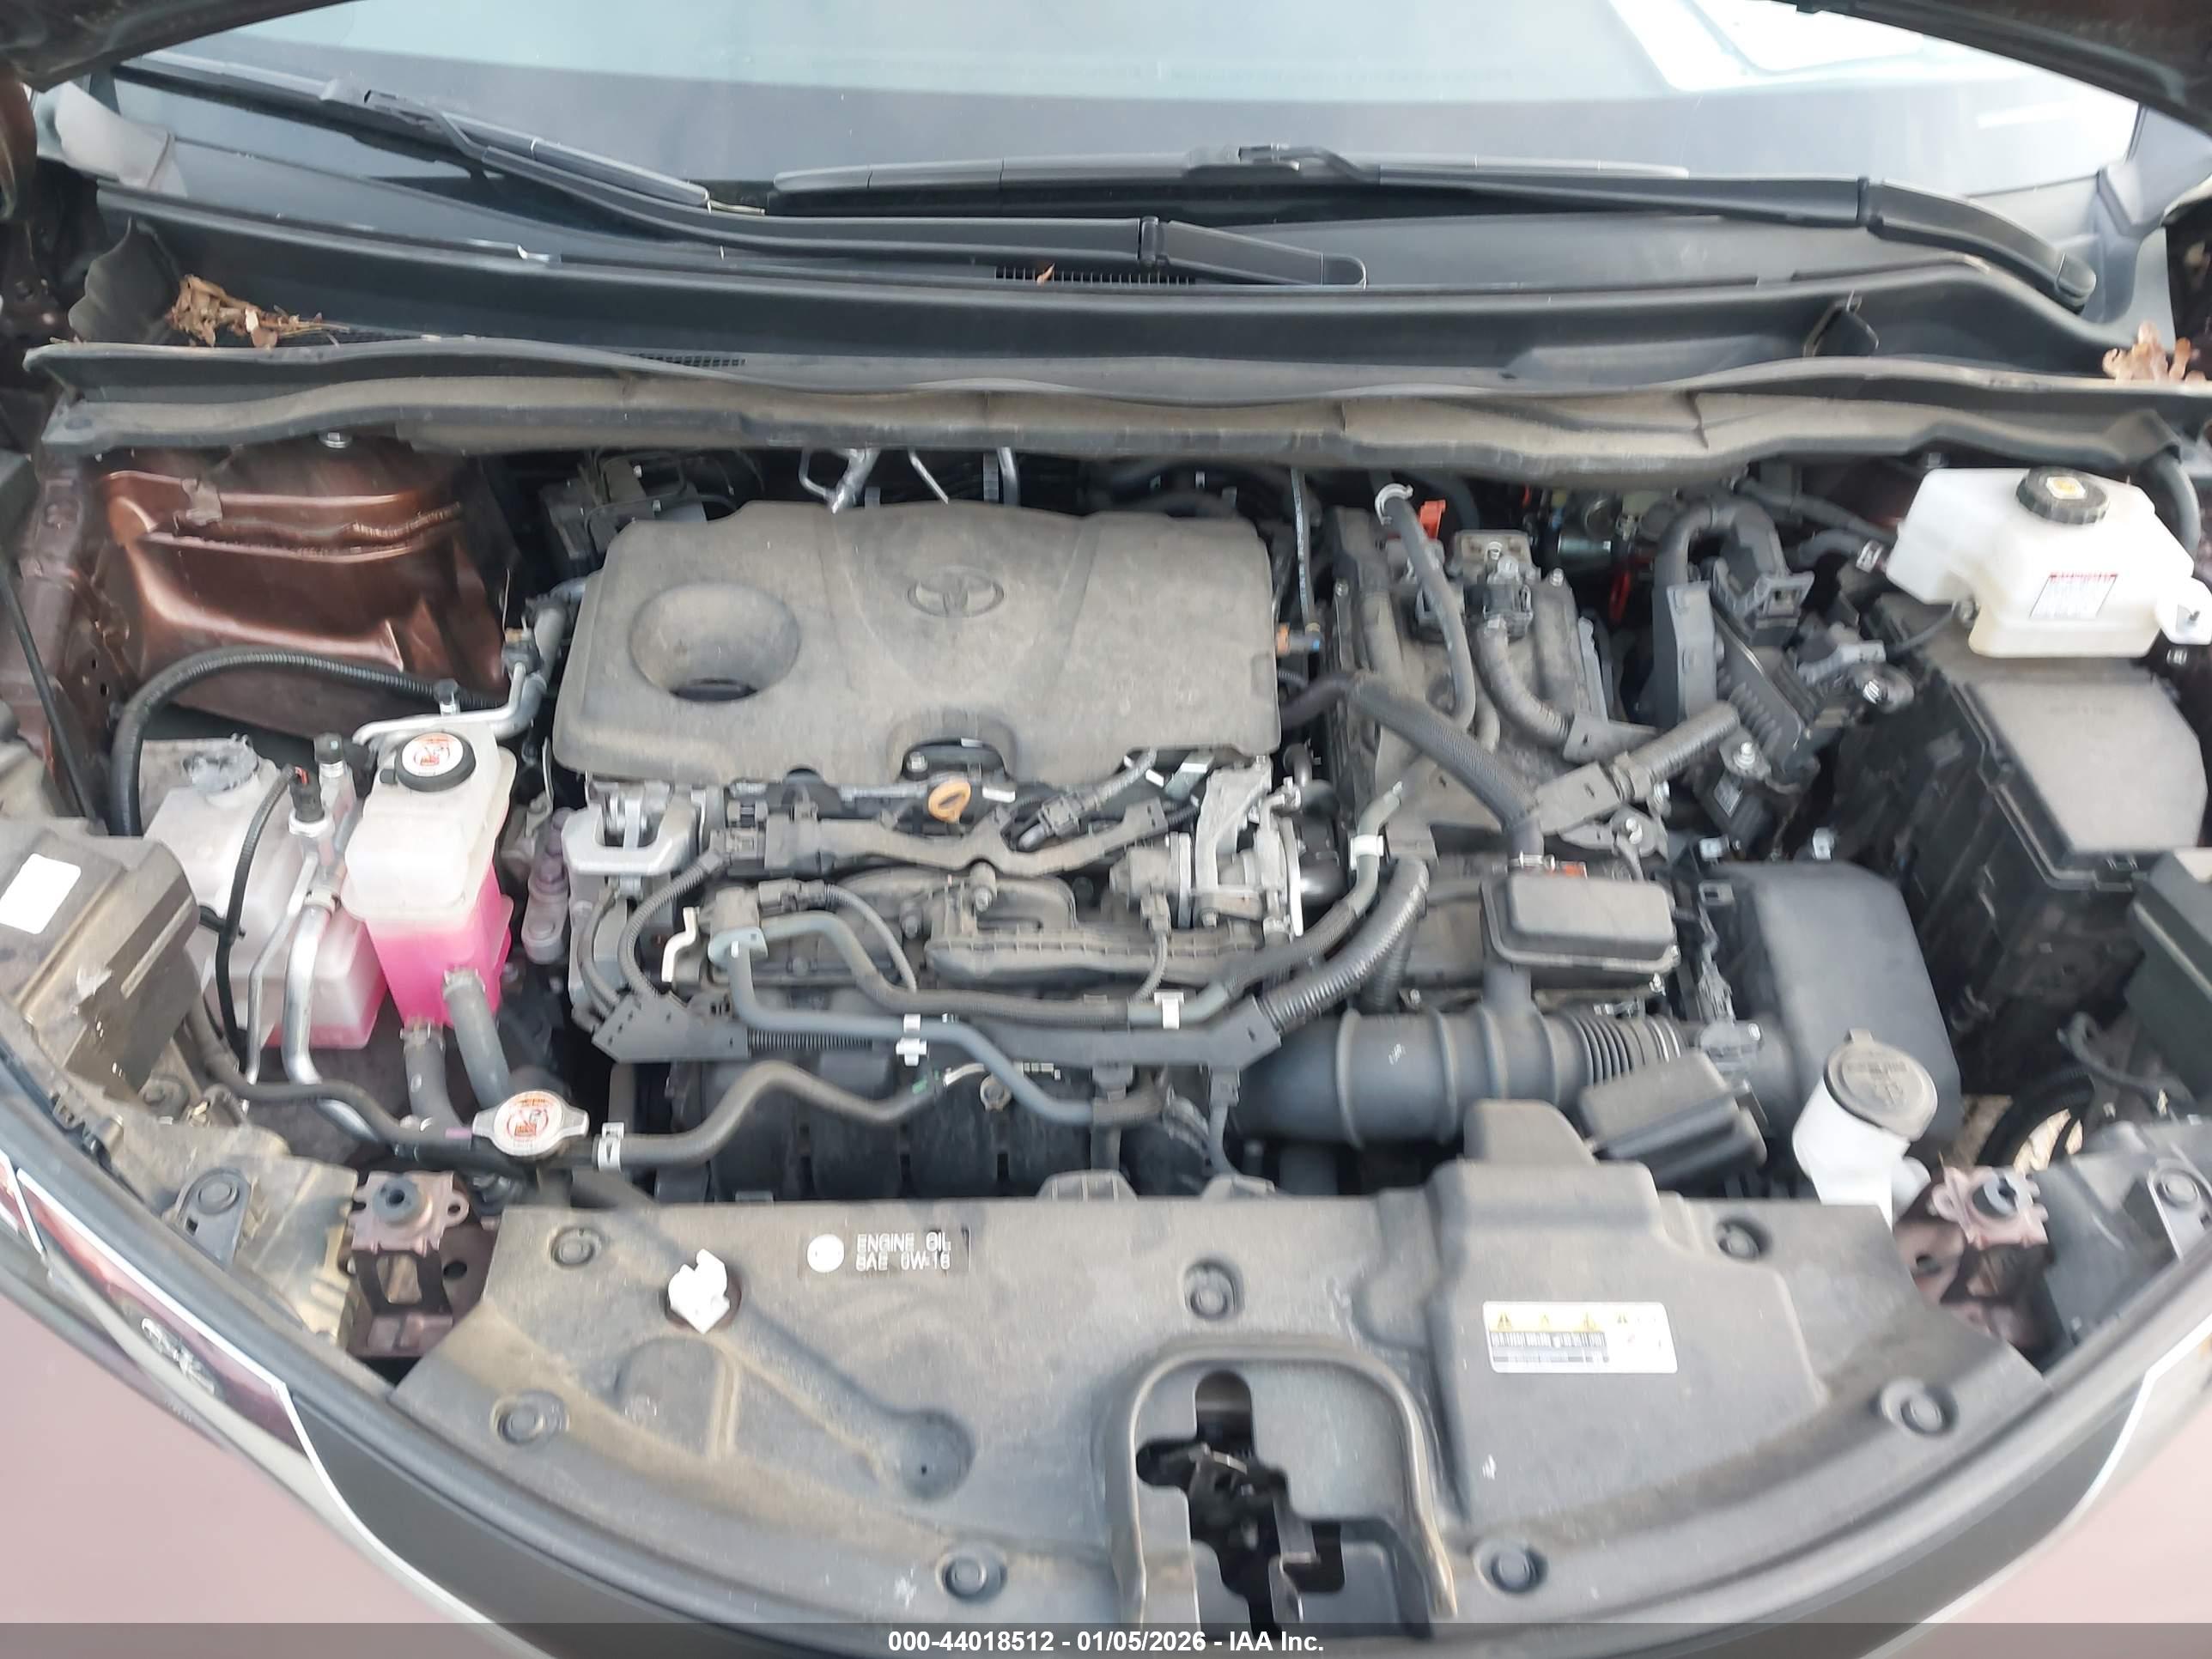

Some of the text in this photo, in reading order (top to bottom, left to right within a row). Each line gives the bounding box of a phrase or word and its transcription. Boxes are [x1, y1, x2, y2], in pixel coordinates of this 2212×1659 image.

[857, 1231, 951, 1252] ENGINE OIL
[855, 1251, 889, 1272] SAE
